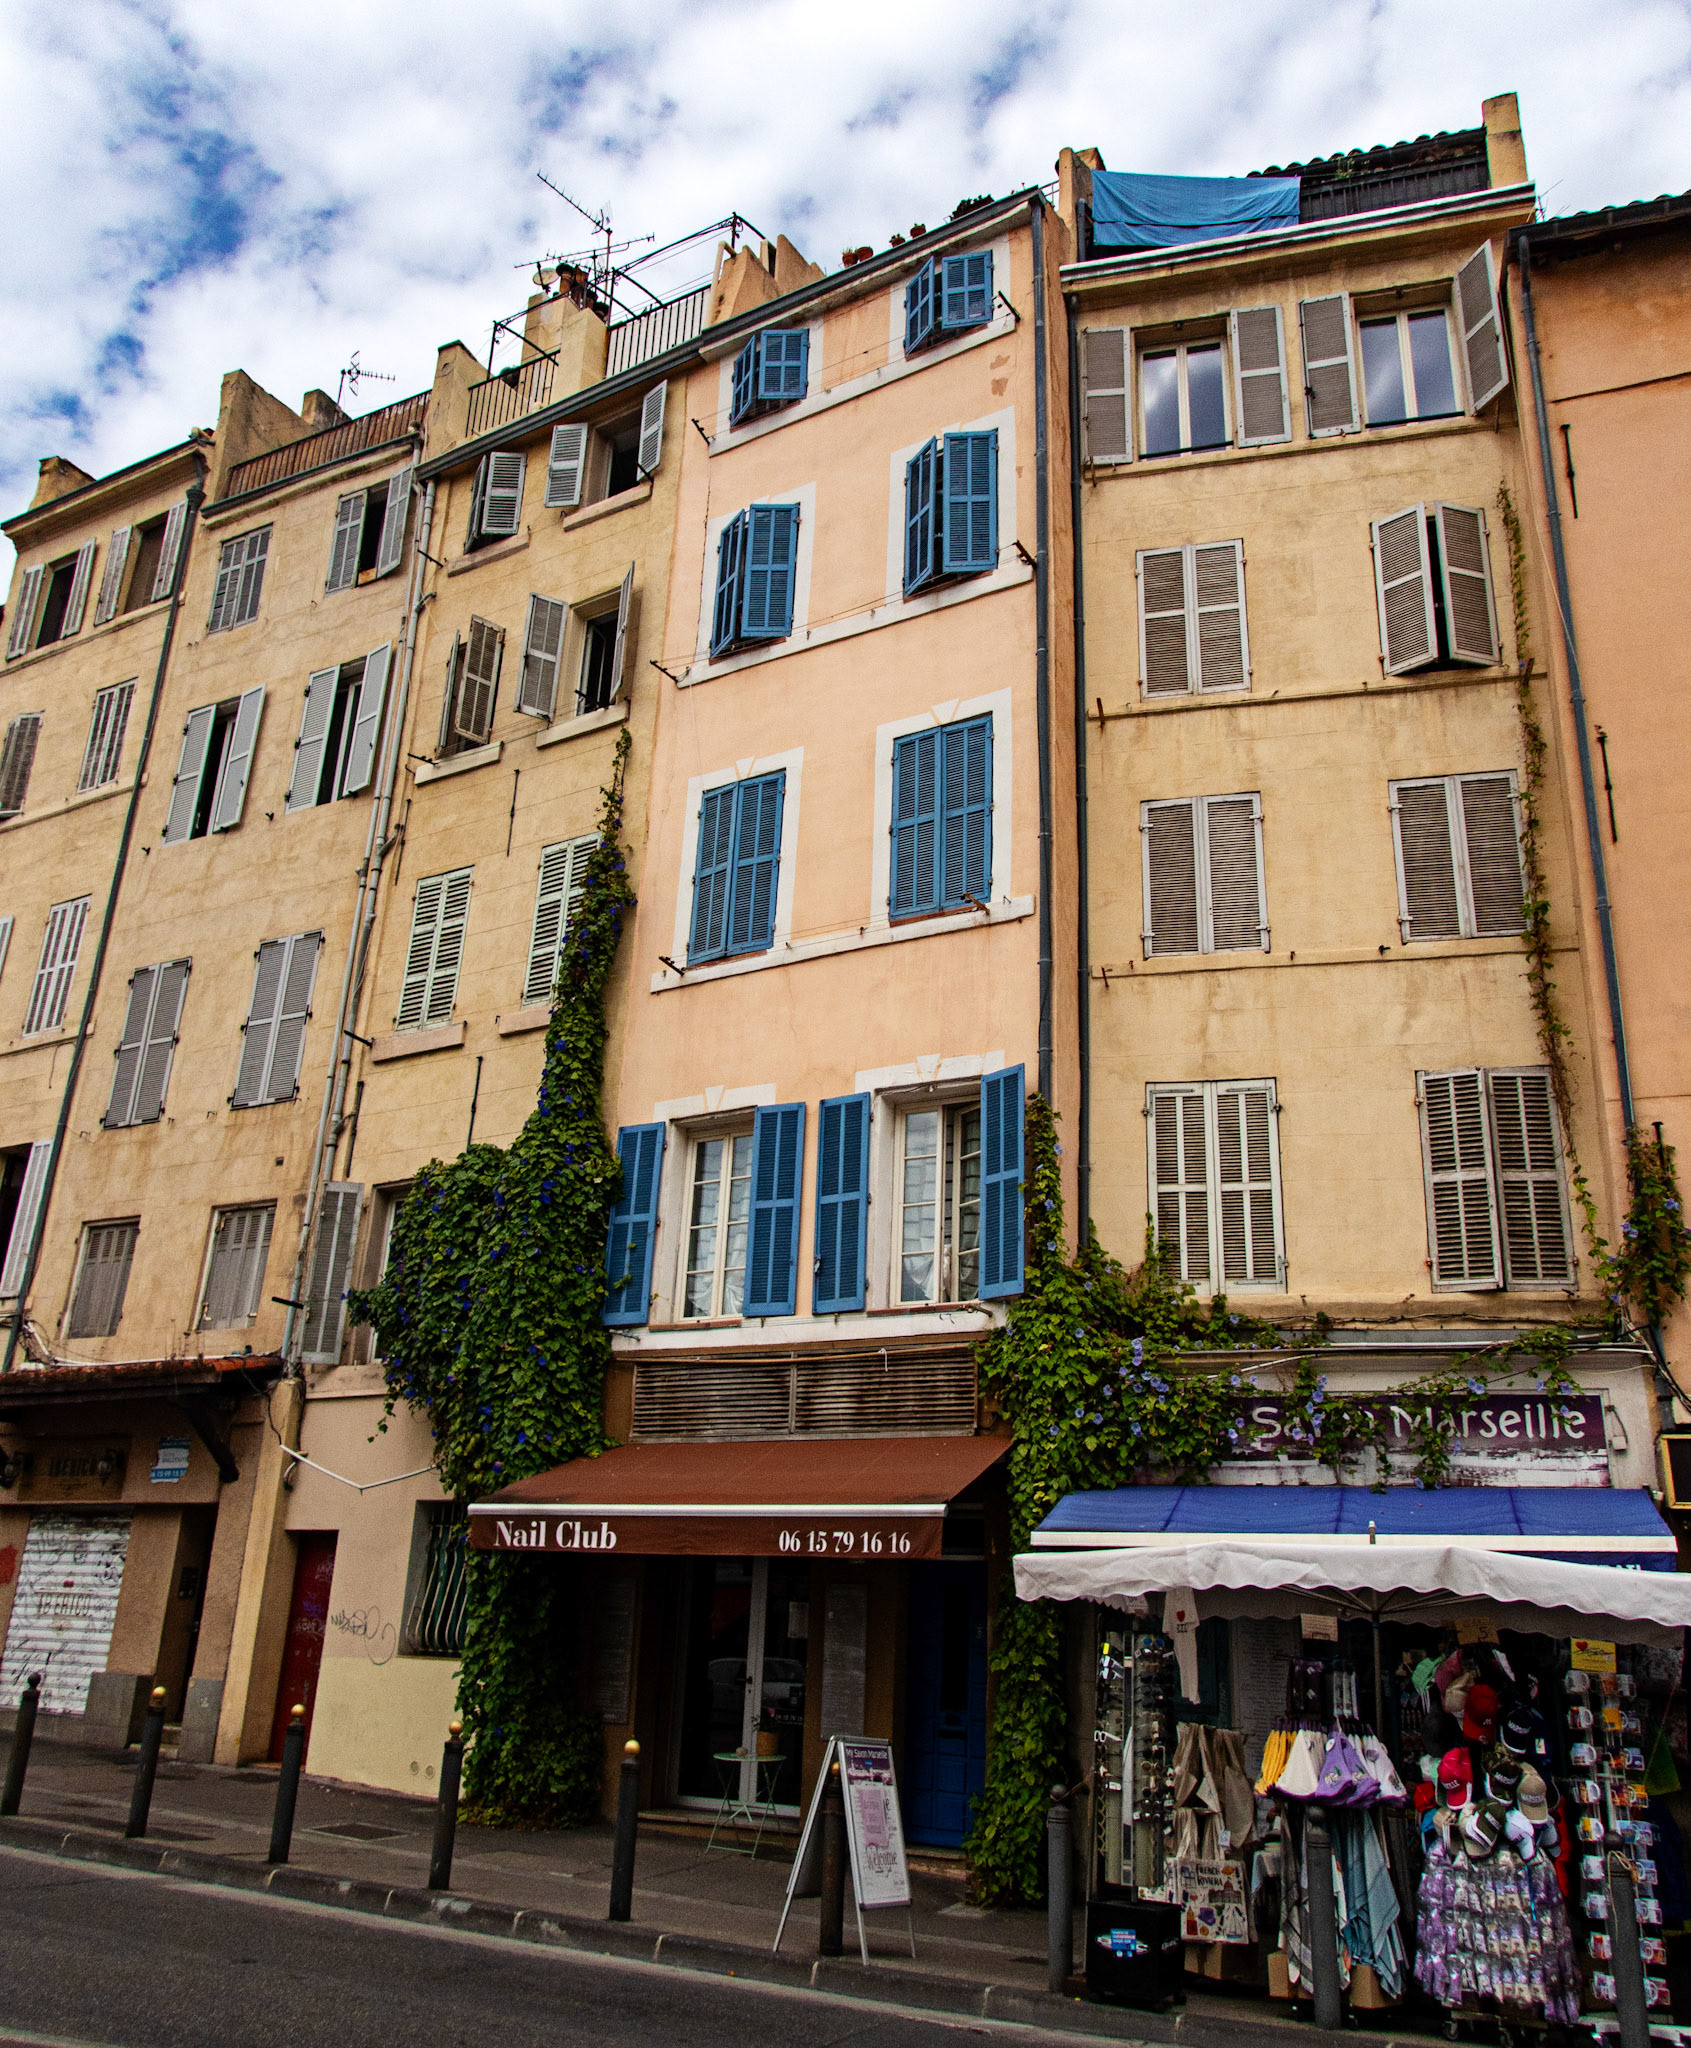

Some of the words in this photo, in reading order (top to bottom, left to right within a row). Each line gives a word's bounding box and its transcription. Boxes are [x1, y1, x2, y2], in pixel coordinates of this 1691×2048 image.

[494, 1520, 547, 1548] Nail
[555, 1520, 617, 1549] Club
[779, 1530, 801, 1552] 06
[806, 1530, 827, 1553] 15
[832, 1531, 854, 1553] 79
[860, 1531, 883, 1553] 16
[888, 1532, 911, 1554] 16
